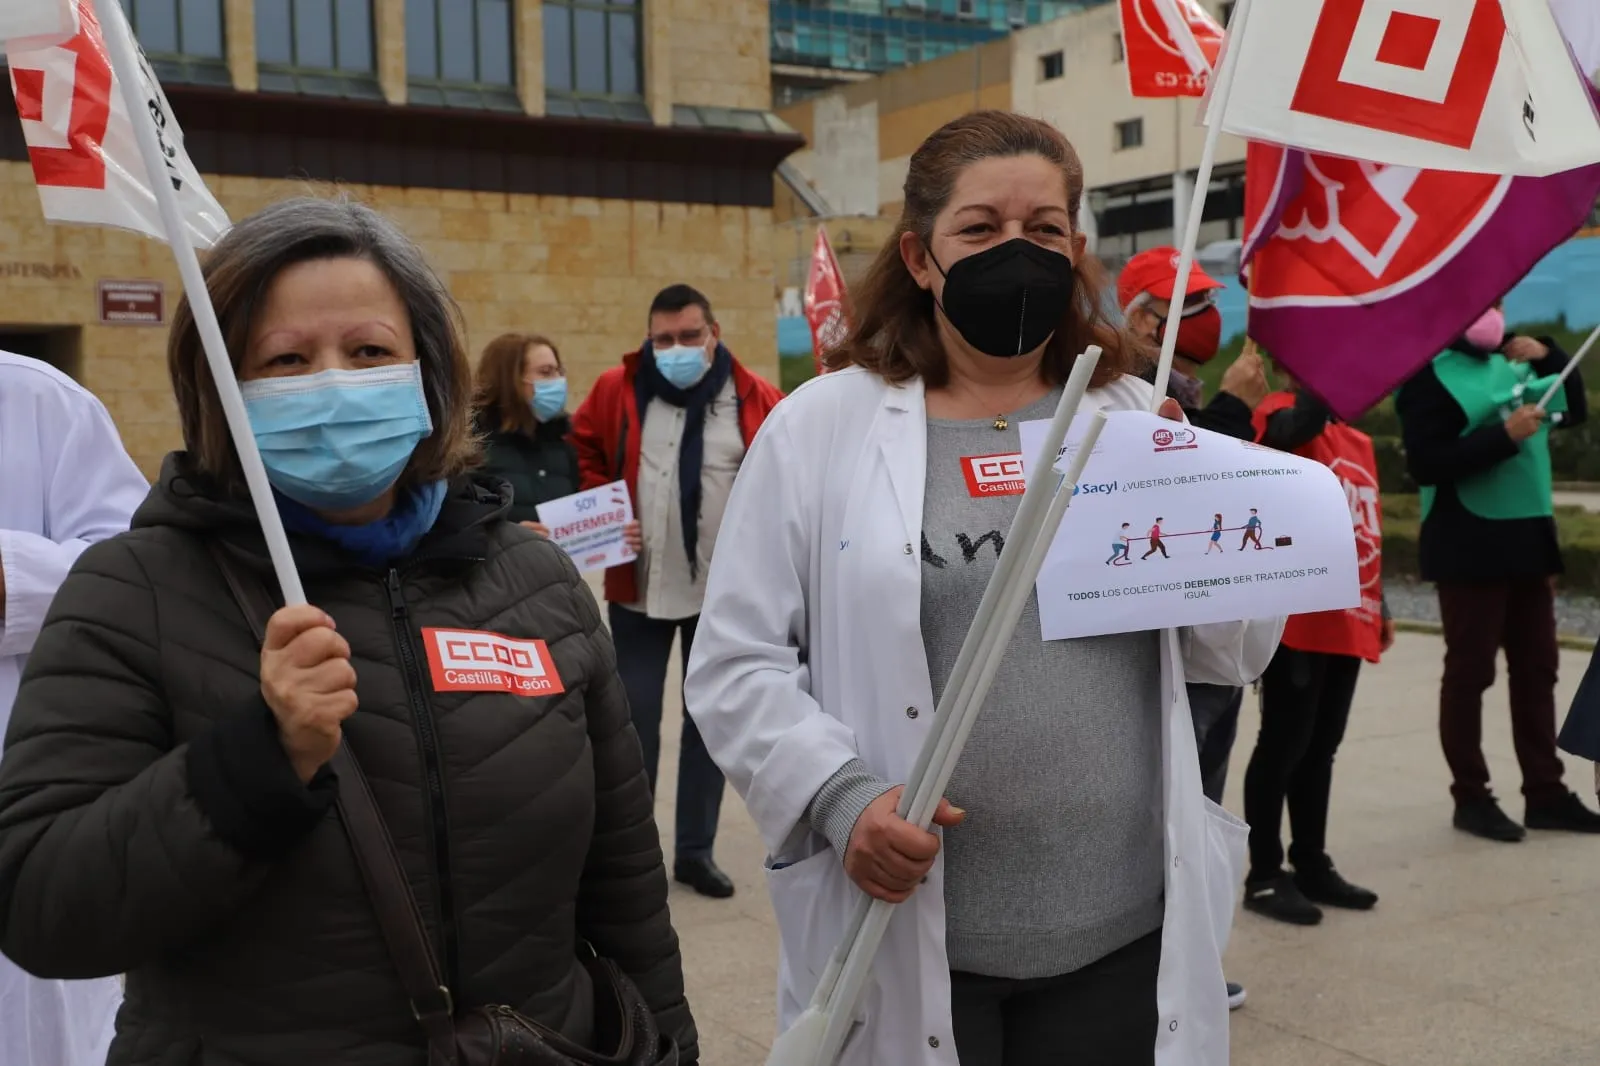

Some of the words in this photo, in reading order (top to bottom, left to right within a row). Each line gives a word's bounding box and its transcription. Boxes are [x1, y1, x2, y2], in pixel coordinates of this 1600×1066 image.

[980, 460, 1024, 477] CC
[978, 480, 1026, 493] Castilla
[1082, 481, 1118, 495] Sacyl
[1122, 477, 1172, 493] ¿VUESTRO
[1173, 471, 1219, 485] OBJETIVO
[1221, 471, 1234, 480] ES
[575, 495, 598, 513] SOY
[554, 508, 626, 540] ENFERMER@
[1067, 590, 1101, 601] TODOS
[1102, 588, 1121, 598] LOS
[1122, 582, 1182, 596] COLECTIVOS
[1184, 577, 1231, 590] DEBEMOS
[1233, 574, 1253, 584] SER
[1255, 569, 1305, 583] TRATADOS
[1307, 567, 1329, 577] POR
[1183, 590, 1212, 600] IGUAL
[446, 640, 534, 669] CCOO
[444, 670, 503, 684] Castilla
[503, 674, 513, 688] y
[514, 676, 551, 690] León
